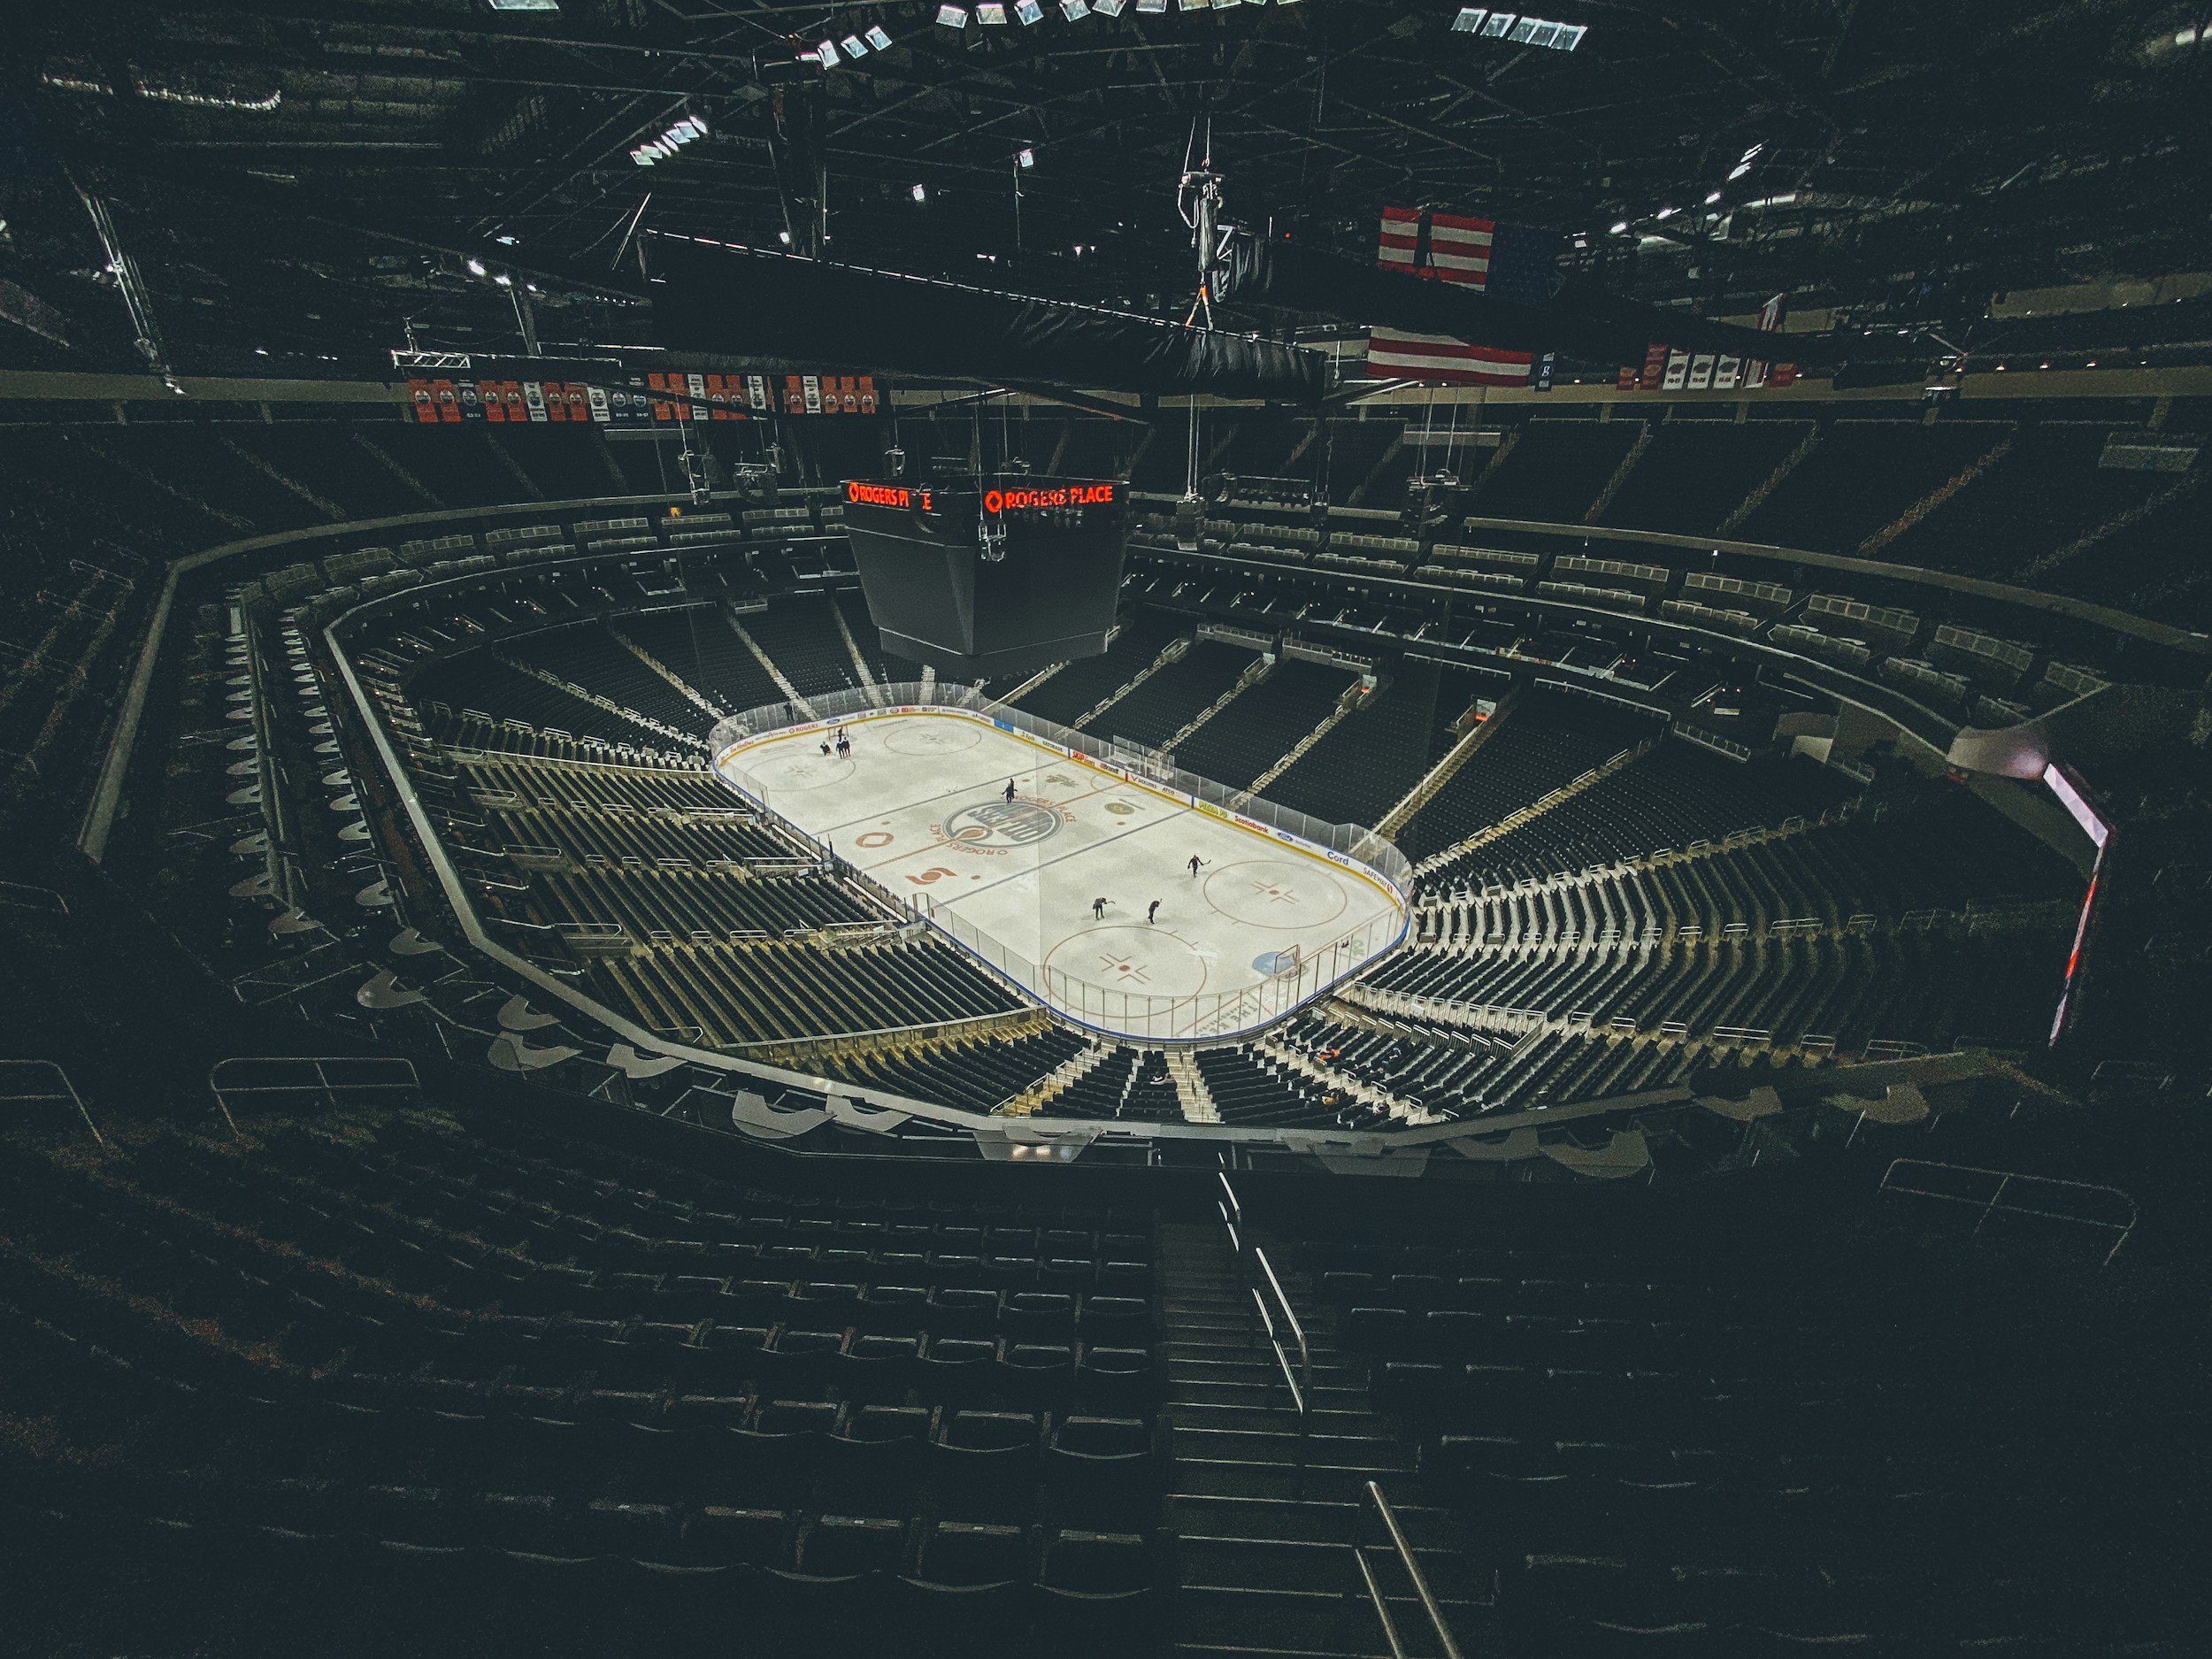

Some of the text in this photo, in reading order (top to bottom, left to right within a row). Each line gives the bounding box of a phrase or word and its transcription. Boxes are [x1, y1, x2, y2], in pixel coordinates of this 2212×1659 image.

[859, 485, 897, 506] ROGERS
[1004, 486, 1114, 510] ROGERS PLACE
[795, 723, 818, 733] ROGERS
[1071, 750, 1085, 761] SKIP
[1234, 815, 1269, 833] Scotiabank
[1327, 850, 1349, 866] Cord
[1363, 867, 1387, 887] SAFEWAY
